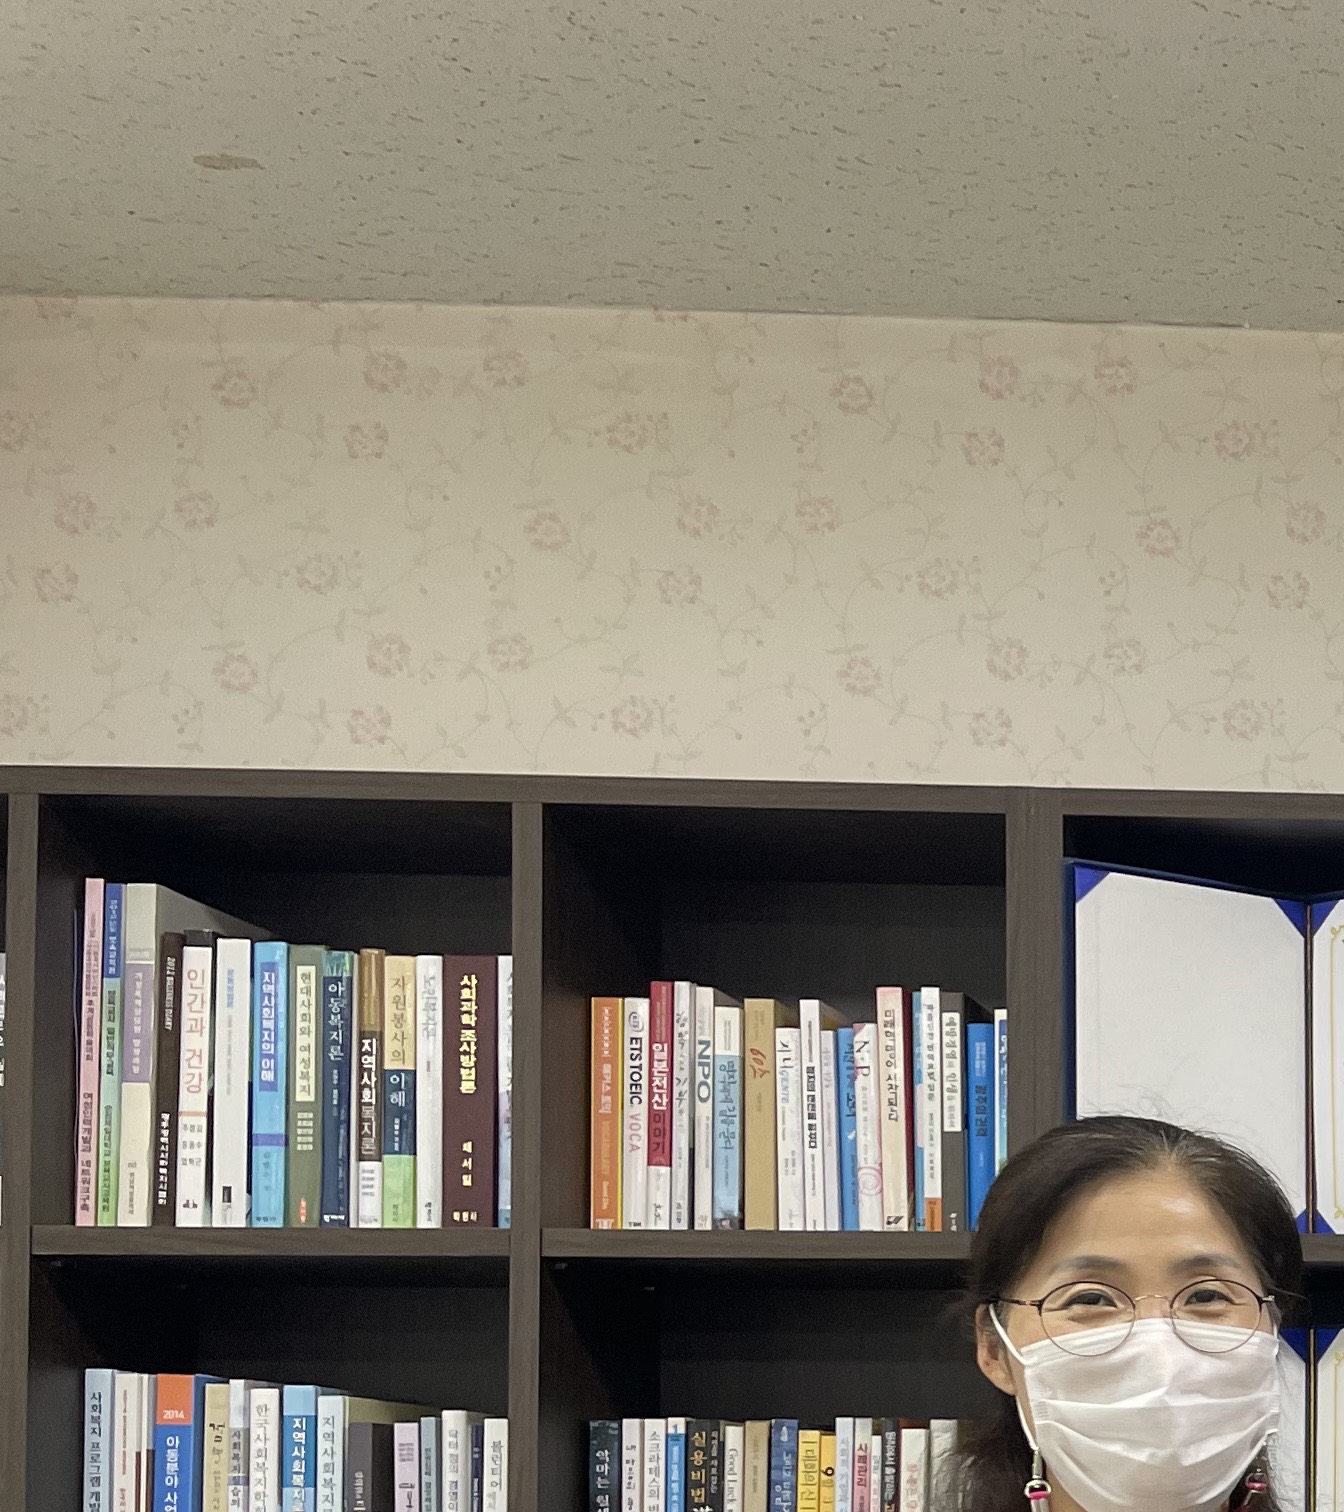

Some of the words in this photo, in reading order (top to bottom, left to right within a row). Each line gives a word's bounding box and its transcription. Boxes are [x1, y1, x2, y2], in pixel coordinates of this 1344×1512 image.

[697, 1039, 711, 1104] NPO
[628, 1113, 641, 1153] VOCA
[162, 1409, 186, 1421] 2014
